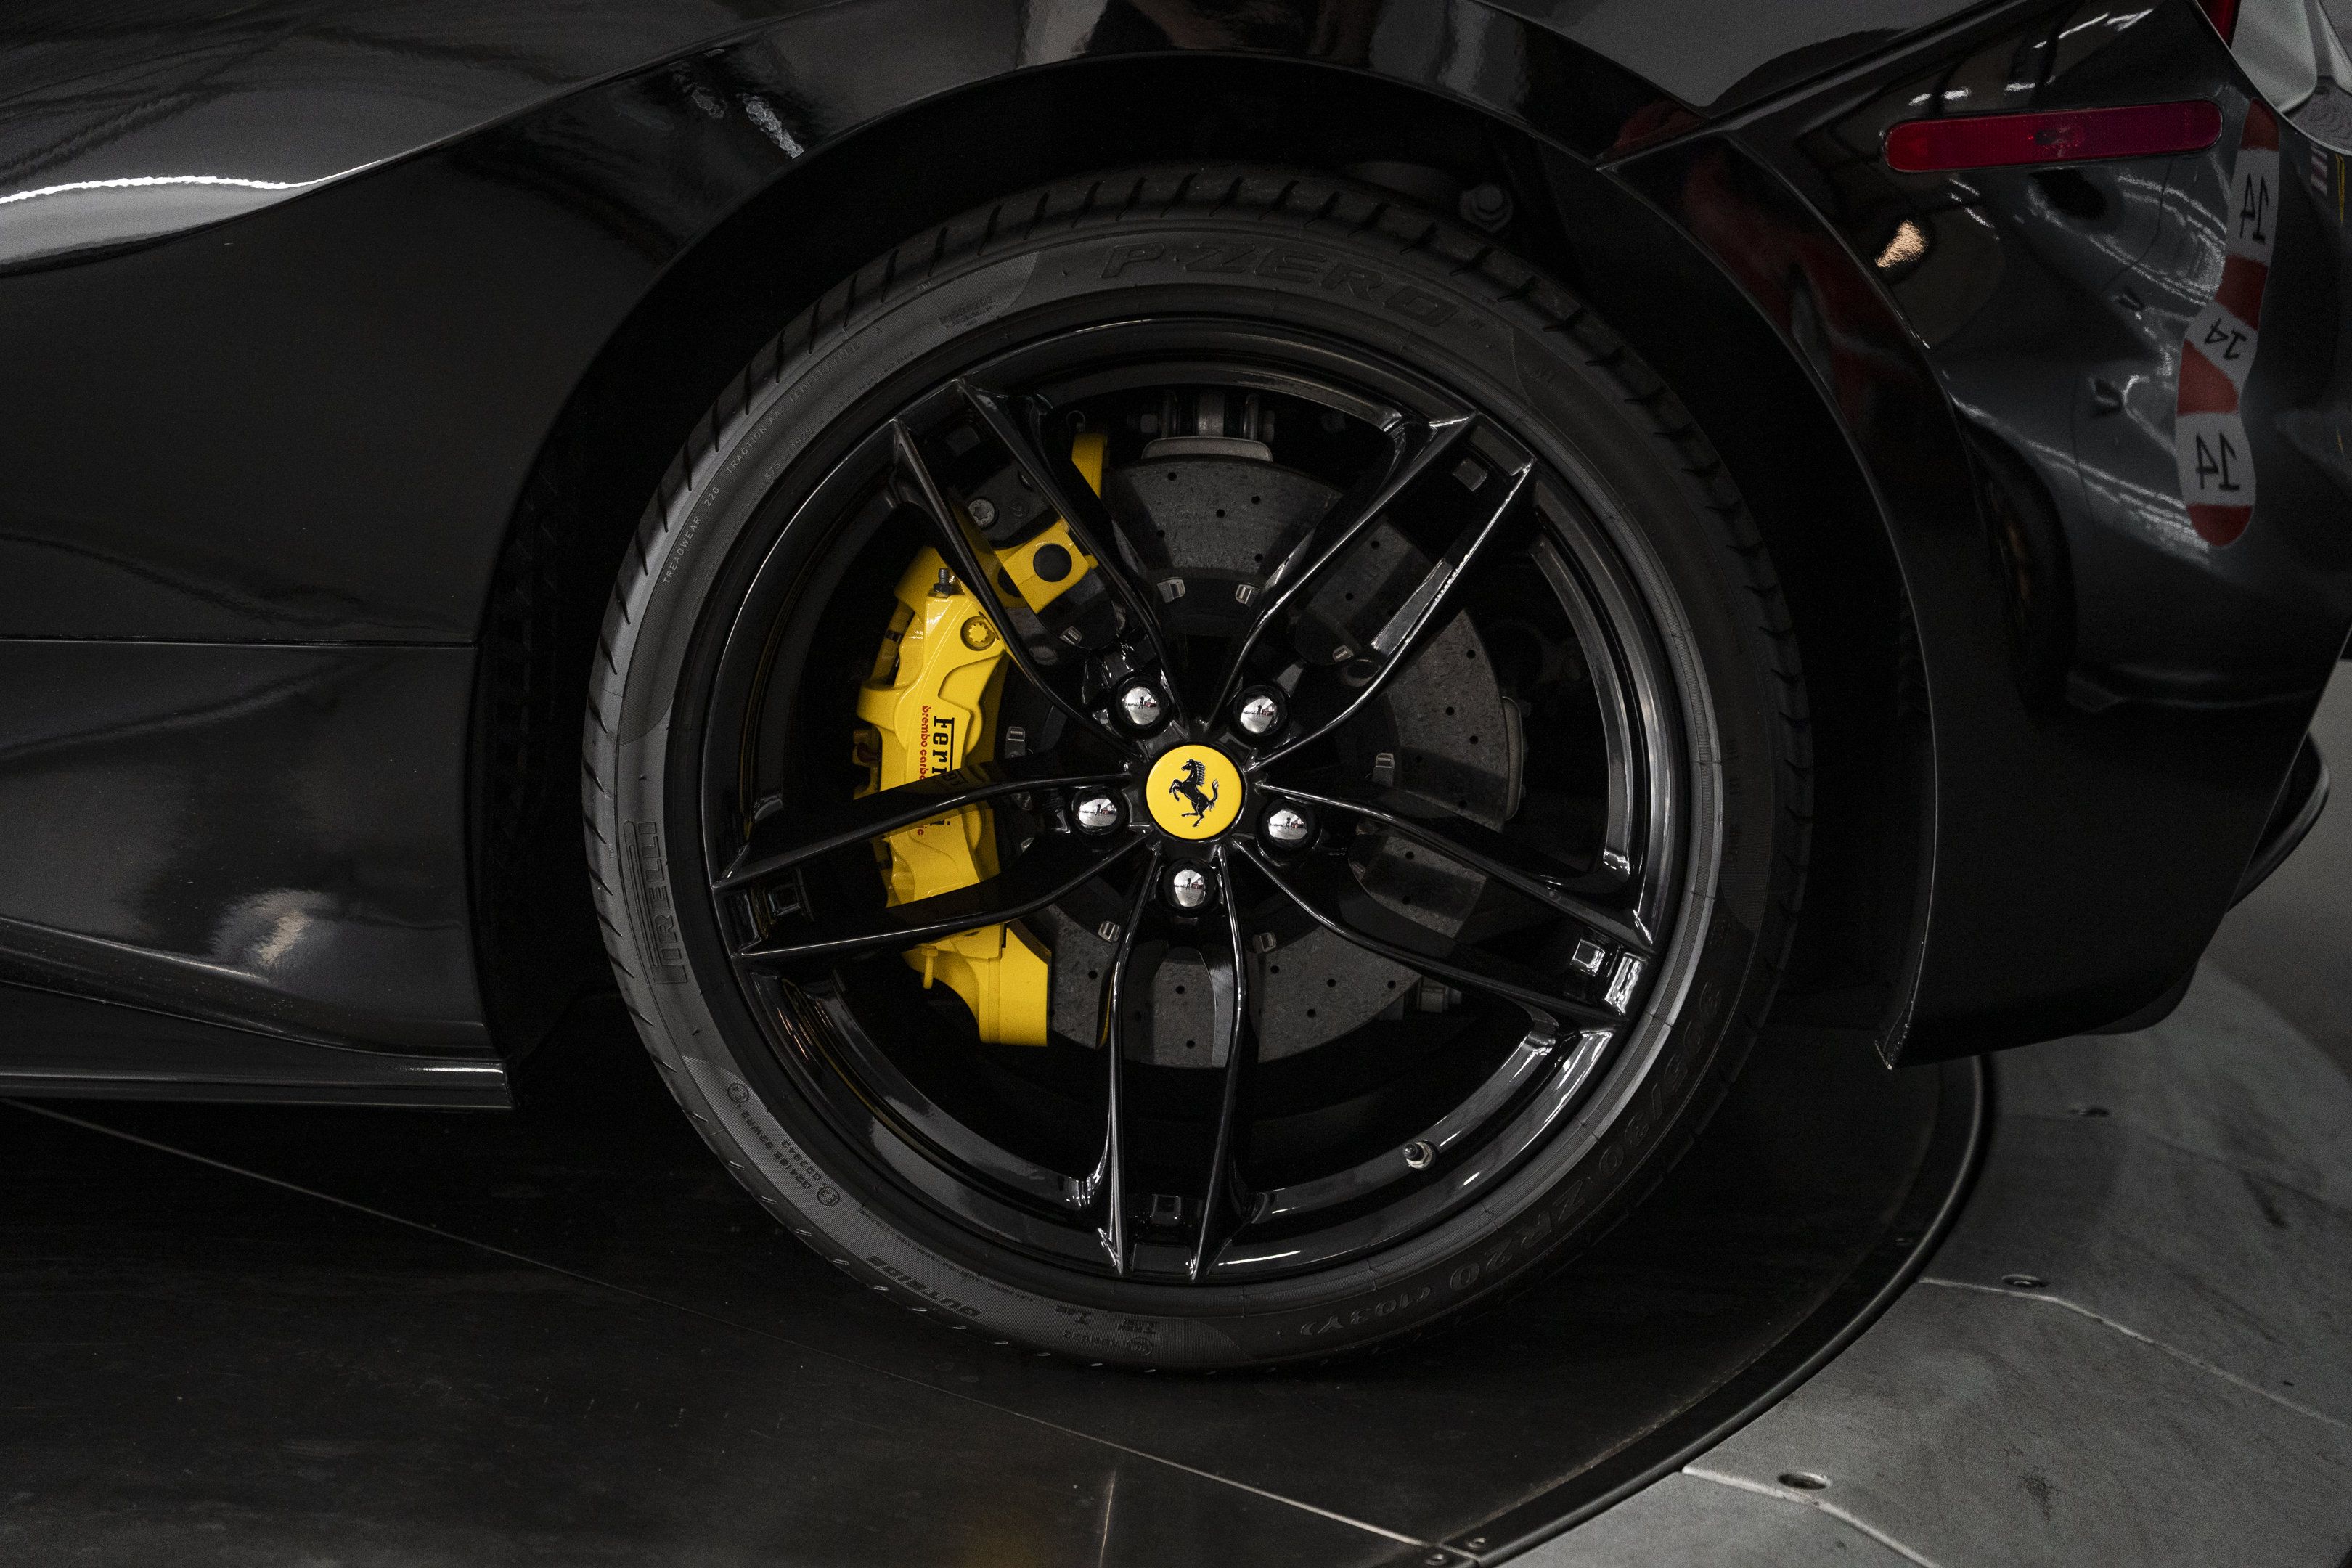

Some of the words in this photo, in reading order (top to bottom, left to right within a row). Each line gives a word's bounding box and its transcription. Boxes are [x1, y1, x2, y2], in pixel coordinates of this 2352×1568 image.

[1184, 237, 1461, 338] ZERO
[661, 515, 703, 584] TREADWEAR
[703, 486, 721, 507] 220
[724, 424, 768, 475] TRACTION
[765, 408, 783, 425] AA
[918, 749, 928, 782] carbo
[920, 706, 932, 748] brembo
[931, 715, 955, 826] Ferri
[621, 819, 689, 984] PIRELLI
[865, 1251, 981, 1320] OUTSIDE
